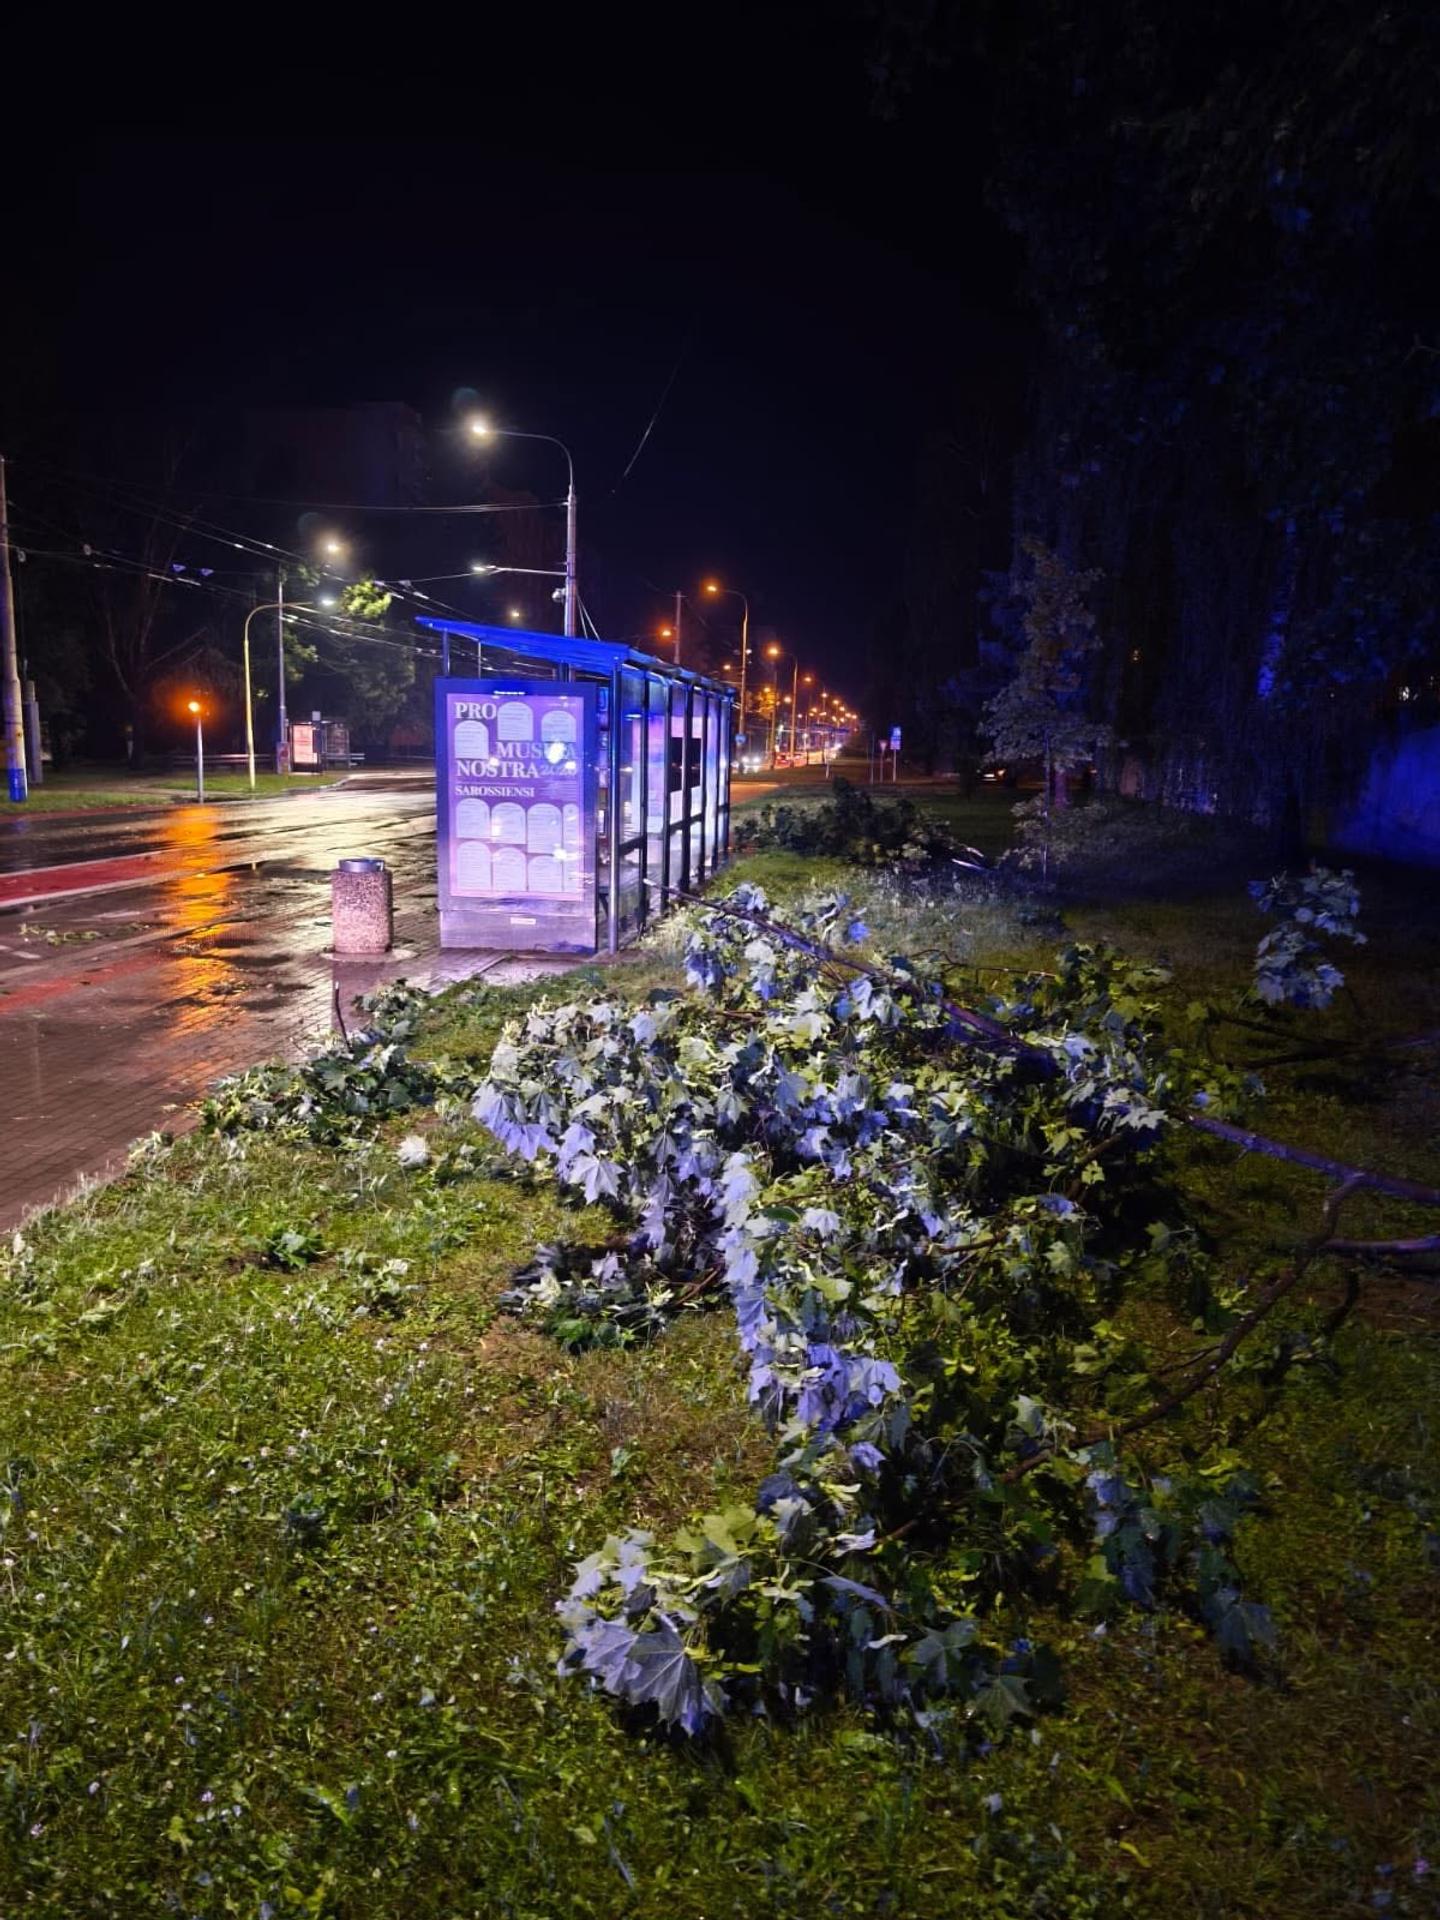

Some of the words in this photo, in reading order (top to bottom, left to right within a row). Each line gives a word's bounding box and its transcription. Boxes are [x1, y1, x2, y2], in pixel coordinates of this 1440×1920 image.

[455, 702, 497, 720] PRO
[496, 742, 578, 760] MUSA
[456, 761, 540, 778] NOSTRA
[454, 785, 535, 798] SAROSSIENSI
